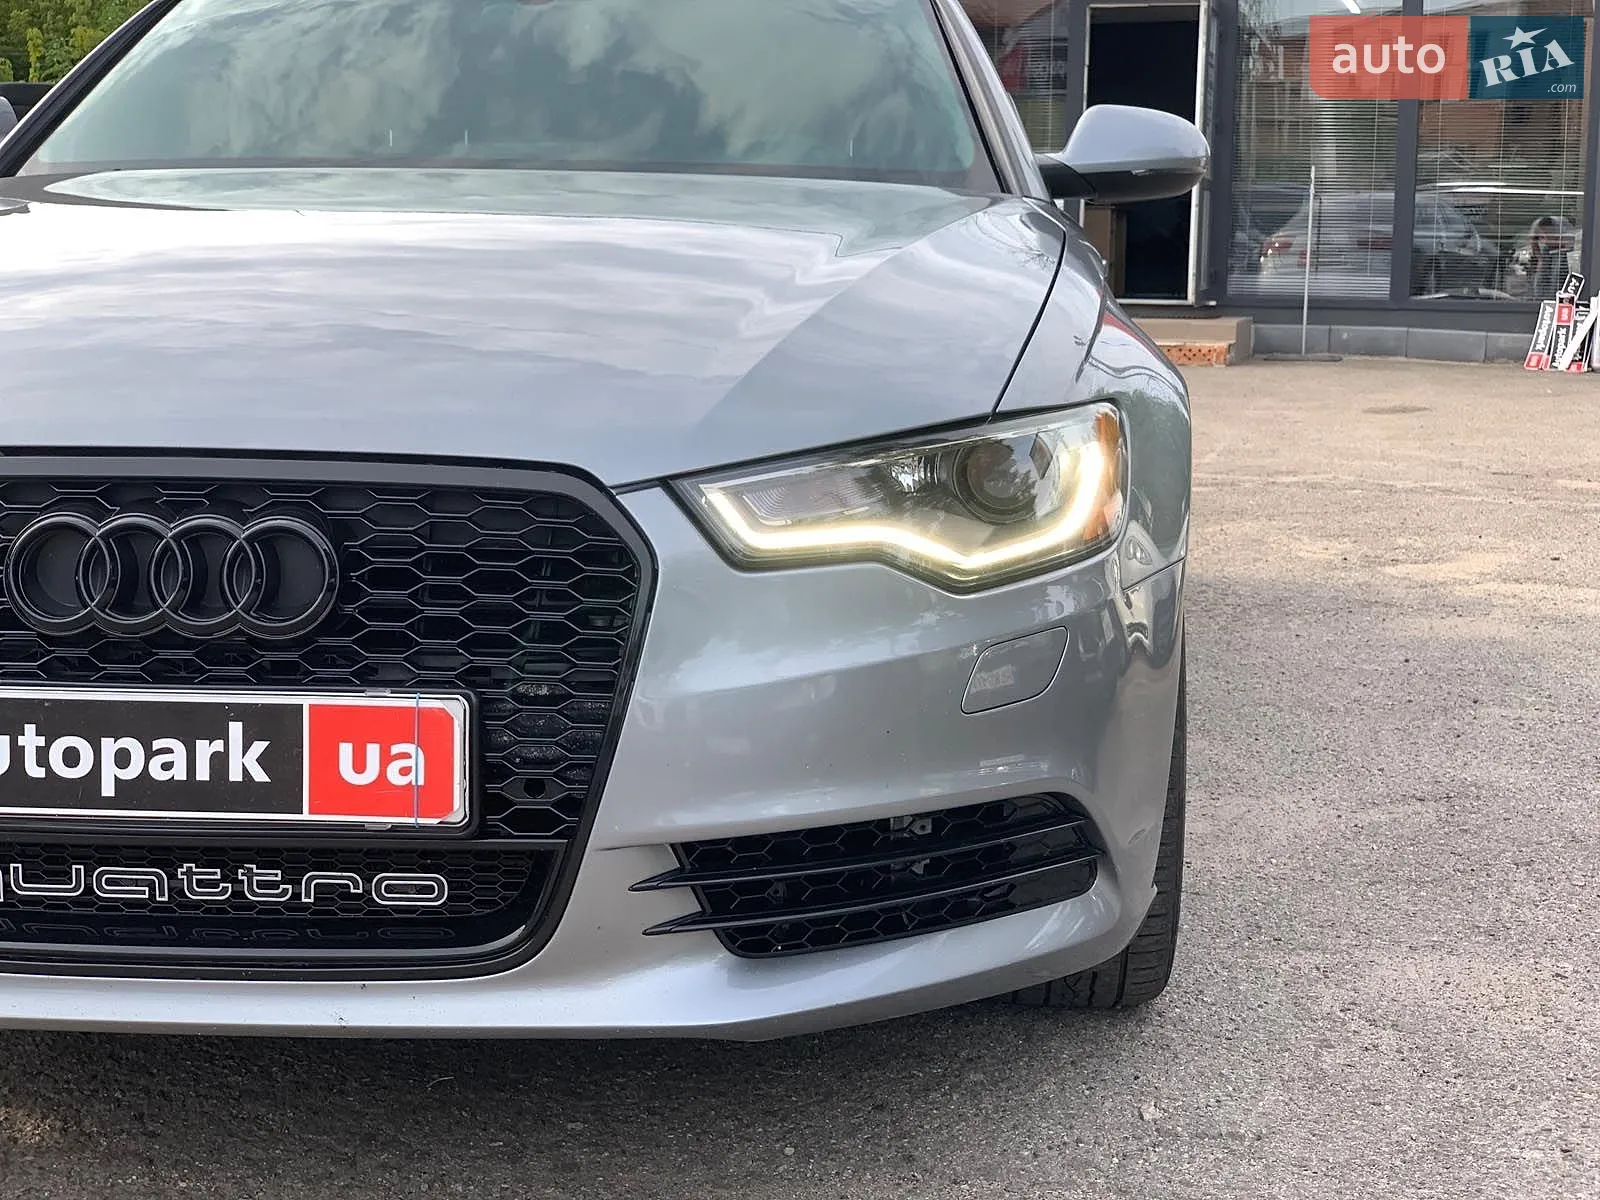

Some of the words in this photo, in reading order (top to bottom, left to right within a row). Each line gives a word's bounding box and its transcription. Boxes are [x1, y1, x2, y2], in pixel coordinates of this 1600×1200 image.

[0, 721, 272, 797] topark
[338, 741, 426, 786] ua
[0, 863, 448, 906] uattro
